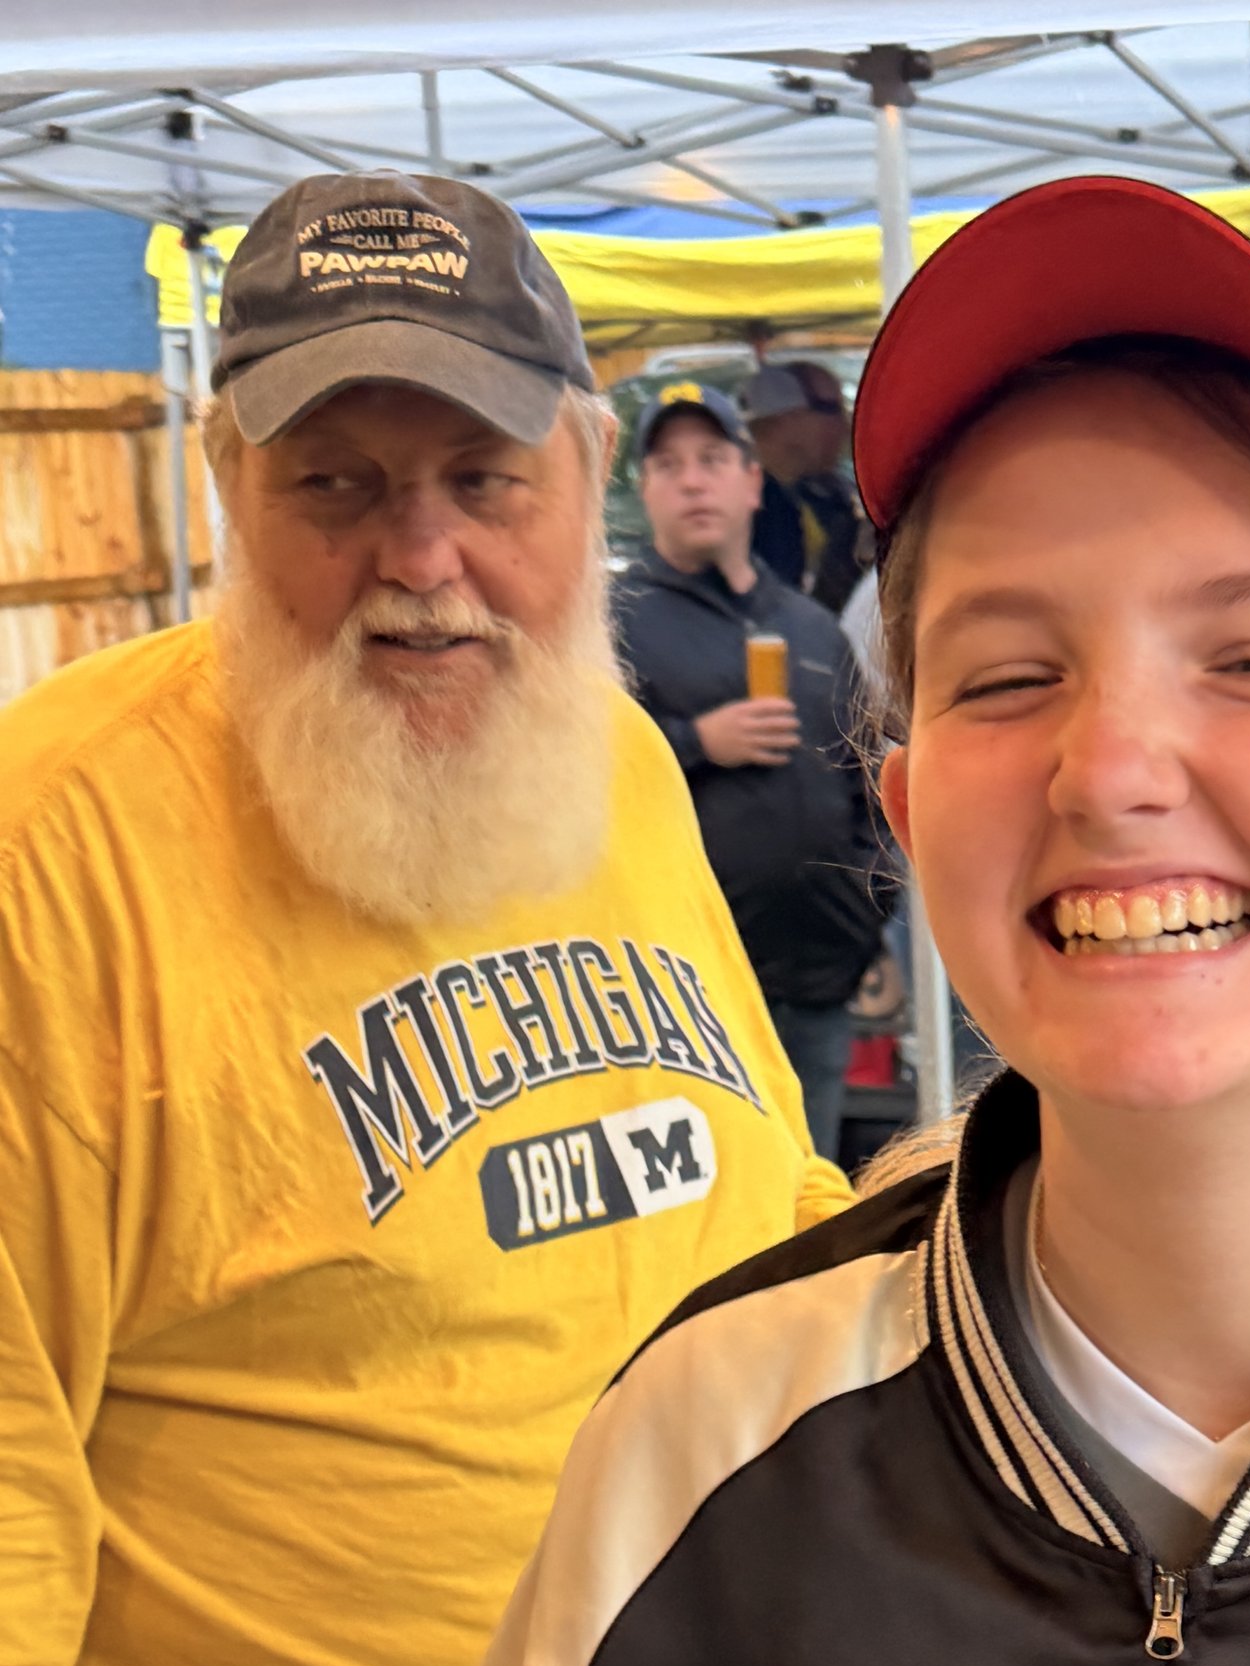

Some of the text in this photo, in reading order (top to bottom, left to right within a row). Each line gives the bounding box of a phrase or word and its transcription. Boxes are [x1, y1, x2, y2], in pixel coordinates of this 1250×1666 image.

[297, 207, 471, 252] MY FAVORITE PEOPLE
[353, 233, 421, 250] CALL ME
[300, 251, 469, 280] PAWPAW
[300, 936, 768, 1227] MICHIGAN
[505, 1116, 709, 1238] 1817 M
